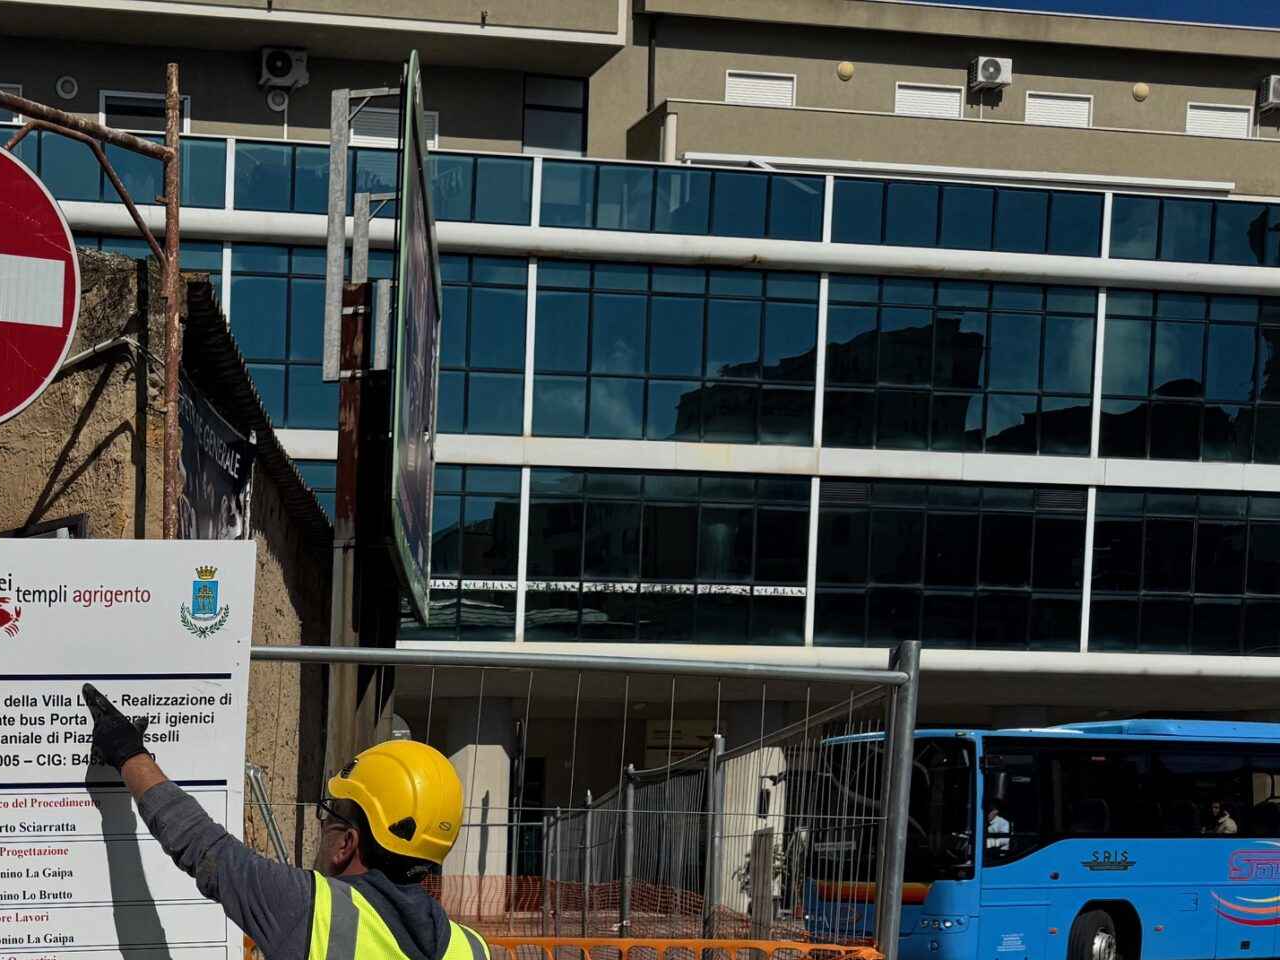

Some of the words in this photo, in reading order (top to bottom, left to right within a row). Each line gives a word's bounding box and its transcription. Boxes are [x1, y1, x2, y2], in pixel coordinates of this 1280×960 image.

[15, 585, 68, 607] templi
[72, 585, 151, 608] agrigento
[3, 694, 38, 708] della
[41, 693, 71, 707] Villa
[120, 693, 215, 707] Realizzazione
[218, 692, 232, 705] di
[19, 712, 46, 726] bus
[50, 712, 87, 725] Porta
[164, 710, 214, 727] igienici
[45, 730, 59, 744] di
[64, 731, 95, 744] Piaz
[144, 730, 180, 743] sselli
[35, 753, 66, 766] CIG:
[10, 797, 27, 808] del
[19, 821, 78, 833] Sciarratta
[25, 867, 39, 878] La
[41, 866, 73, 880] Gaipa
[21, 890, 36, 901] Lo
[38, 889, 73, 900] Brutto
[15, 911, 49, 923] Lavori
[26, 934, 40, 944] La
[43, 933, 75, 946] Gaipa
